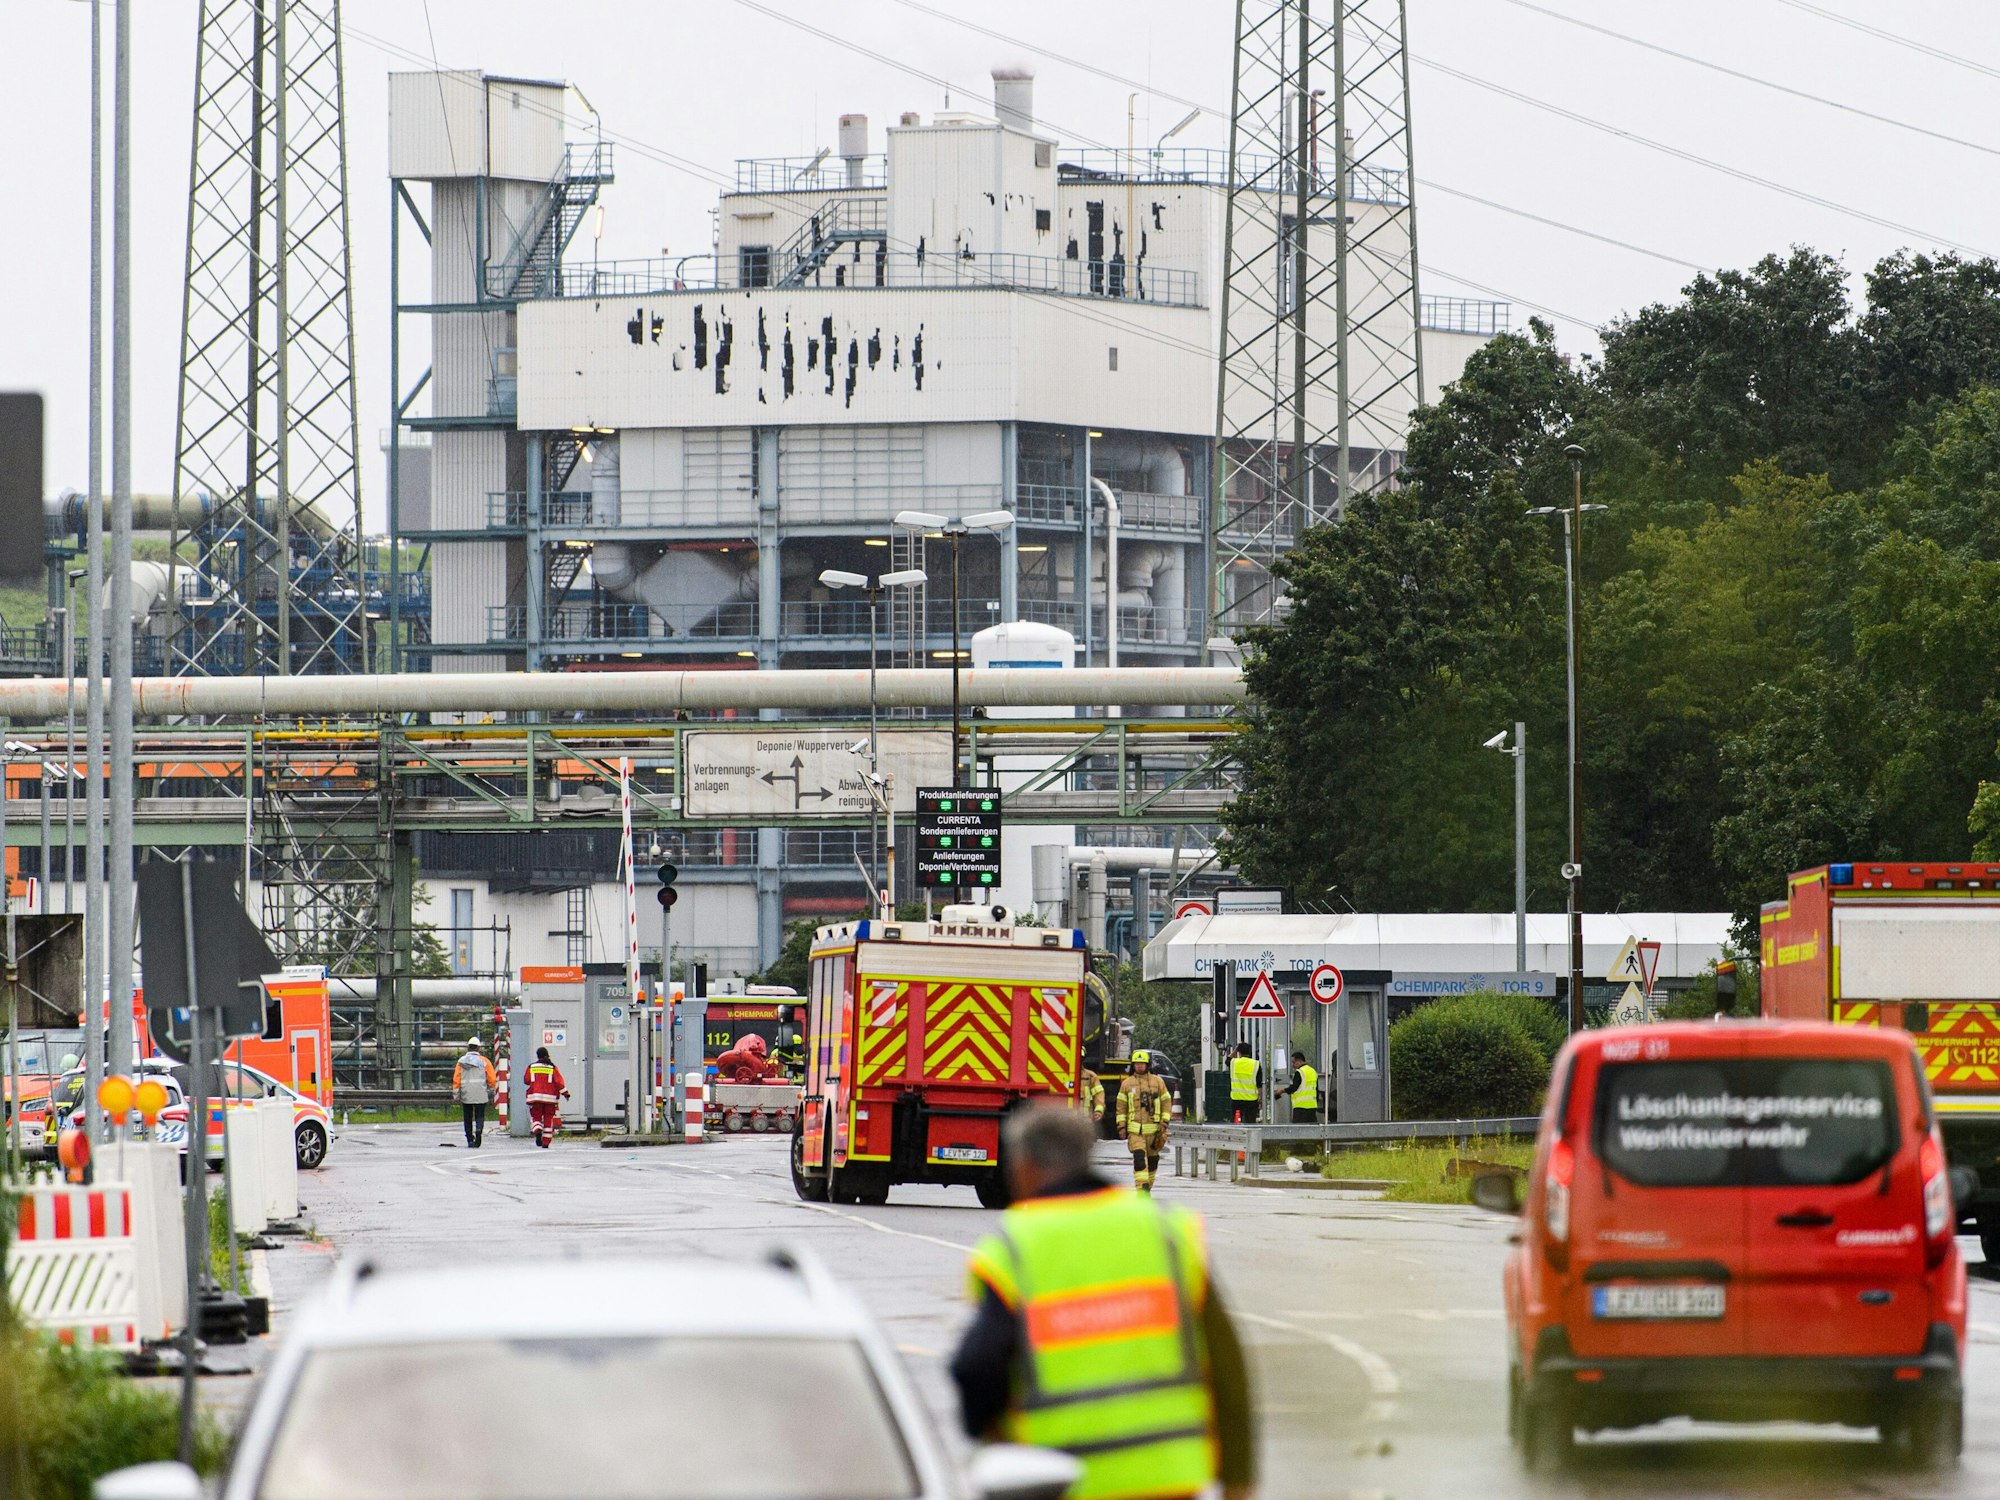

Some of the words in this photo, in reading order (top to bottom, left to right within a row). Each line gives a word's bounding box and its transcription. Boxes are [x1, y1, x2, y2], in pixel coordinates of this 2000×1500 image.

[694, 764, 761, 778] Verbrennungs-
[694, 780, 729, 793] anlagen
[919, 791, 999, 801] Produktanlieferungen
[937, 816, 981, 824] CURRENTA
[920, 827, 998, 837] Sonderanlieferungen
[932, 852, 985, 862] Anlieferungen
[919, 862, 999, 873] Deponie/Verbrennung
[1289, 959, 1314, 971] TOR
[1394, 981, 1467, 993] CHEMPARK
[1502, 981, 1530, 992] TOR
[1535, 981, 1544, 993] 9
[707, 1032, 730, 1046] 112
[1969, 1047, 1999, 1065] 112
[1618, 1092, 1883, 1123] Löschanlagenservice
[1618, 1121, 1810, 1150] Werkfeuerwehr
